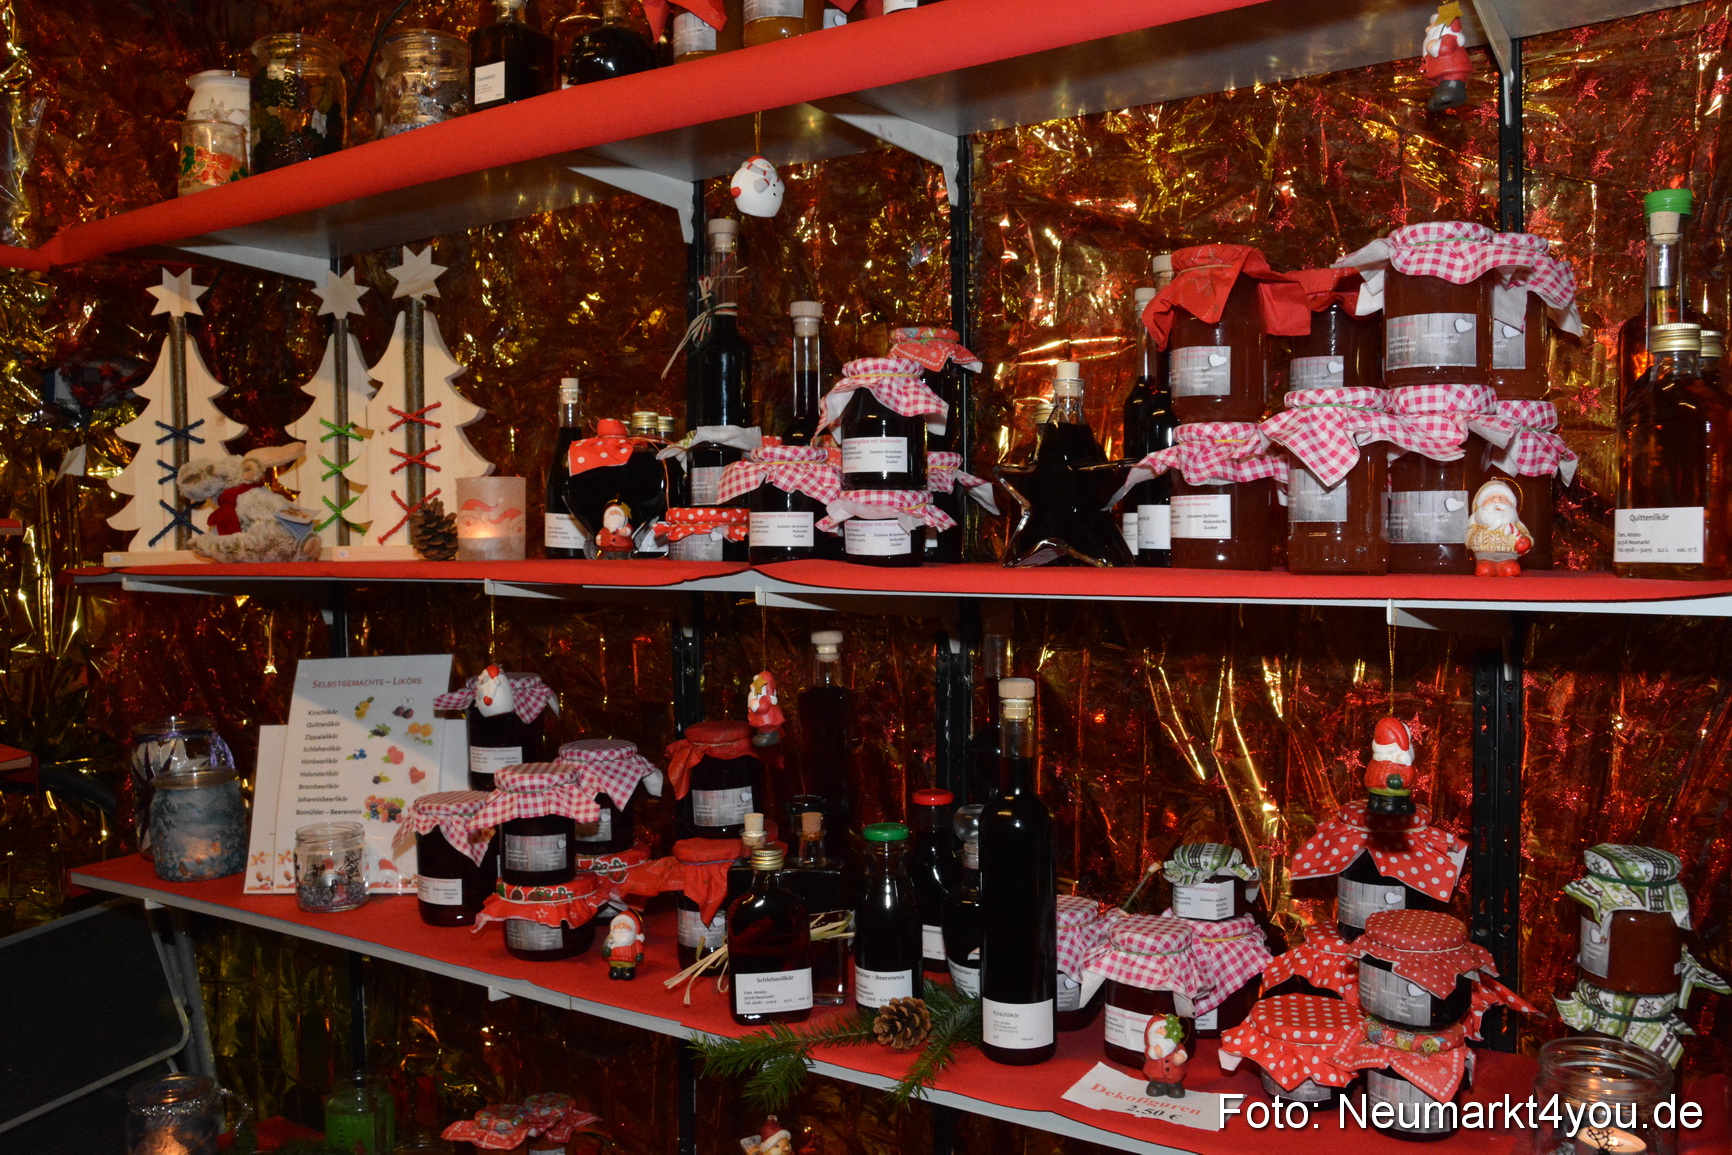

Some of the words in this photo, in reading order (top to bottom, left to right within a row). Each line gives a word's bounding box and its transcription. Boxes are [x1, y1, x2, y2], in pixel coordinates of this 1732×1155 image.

[1629, 513, 1670, 523] Quittenlikör
[306, 721, 341, 729] Quittenlikör
[297, 795, 348, 803] Johannisbeerlikör
[756, 975, 794, 983] Schlehenlikör
[993, 1010, 1020, 1018] Kirschlikör
[1091, 1083, 1201, 1115] Dekofiguren
[1126, 1104, 1165, 1118] 2.50
